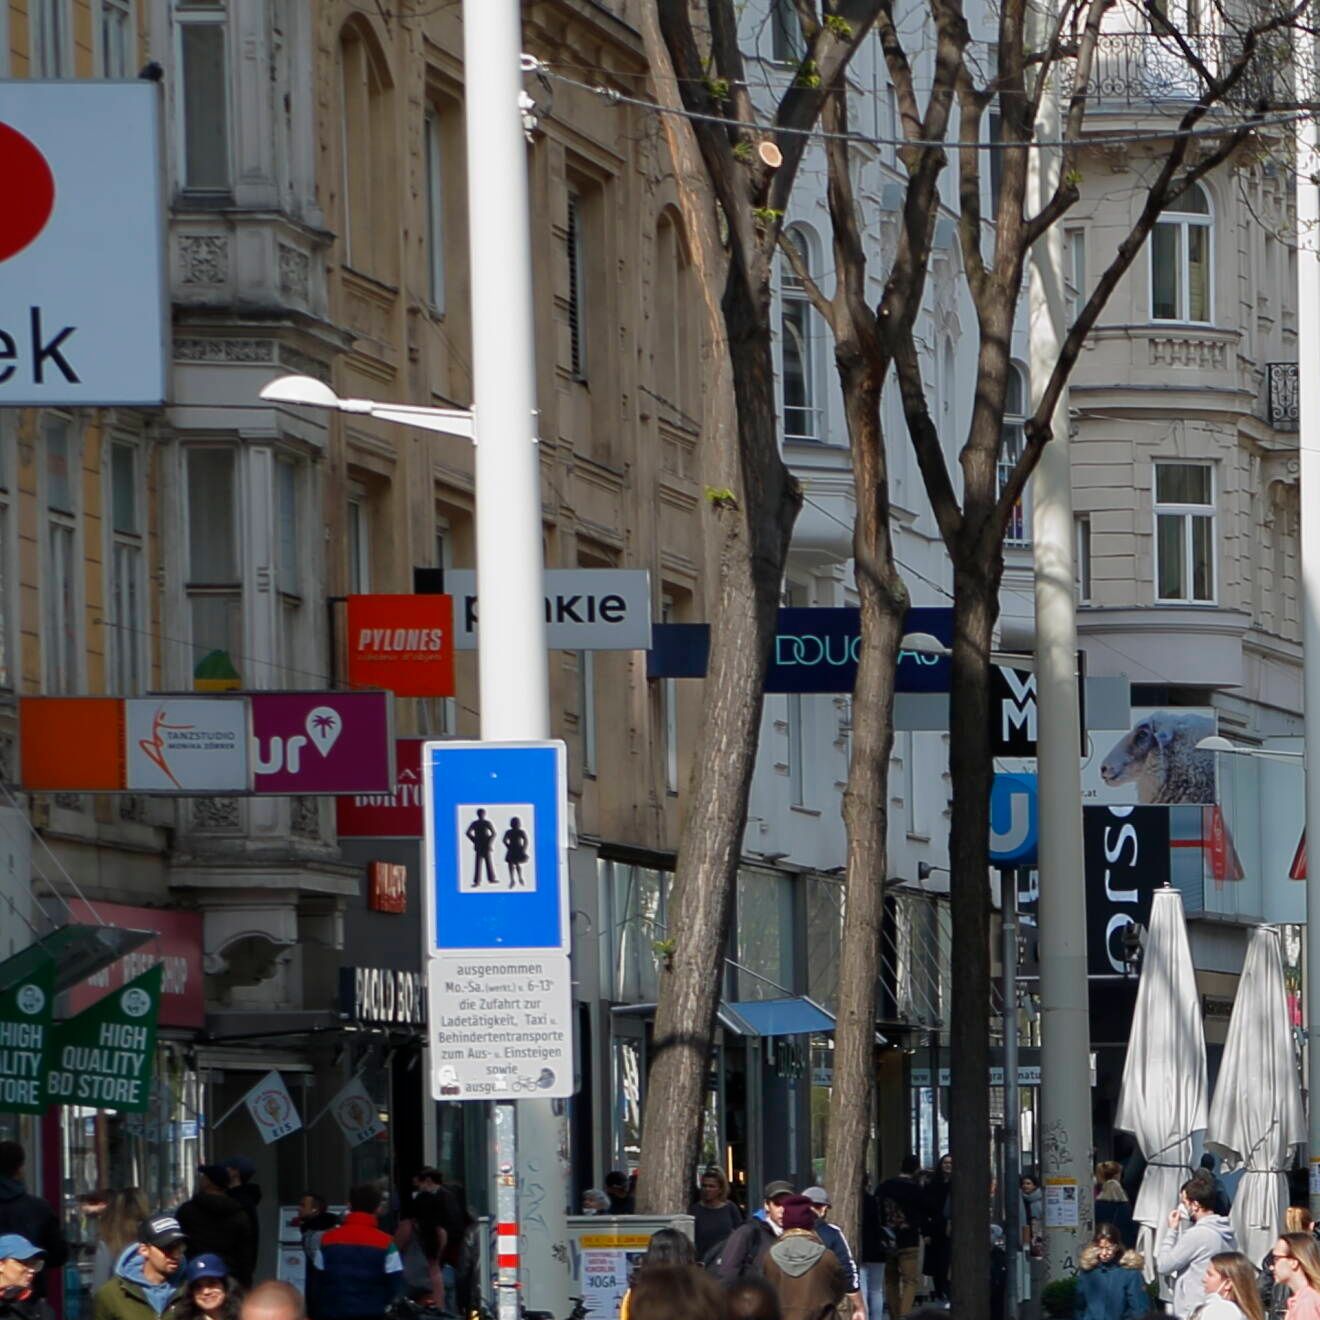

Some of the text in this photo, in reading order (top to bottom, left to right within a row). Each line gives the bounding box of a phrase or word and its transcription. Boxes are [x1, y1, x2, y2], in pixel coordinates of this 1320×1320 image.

[464, 594, 627, 633] pkie
[357, 628, 443, 651] PYLONES
[776, 635, 940, 666] DOUA
[167, 731, 236, 740] TANZSTUDIO
[456, 964, 543, 979] ausgenommen
[445, 981, 485, 993] Mo.-Sa.
[459, 999, 542, 1010] die Zufahrt zur
[525, 1014, 547, 1025] Taxi
[0, 1022, 43, 1049] HIGH
[100, 1022, 148, 1050] HIGH
[439, 1031, 564, 1044] Behindertentransporte
[0, 1051, 42, 1077] LITY
[62, 1046, 146, 1077] QUALITY
[441, 1050, 464, 1060] zum
[467, 1048, 492, 1060] Aus-
[504, 1047, 562, 1060] Einsteigen
[486, 1062, 518, 1075] sowie
[0, 1078, 41, 1105] TORE
[78, 1074, 142, 1104] STORE
